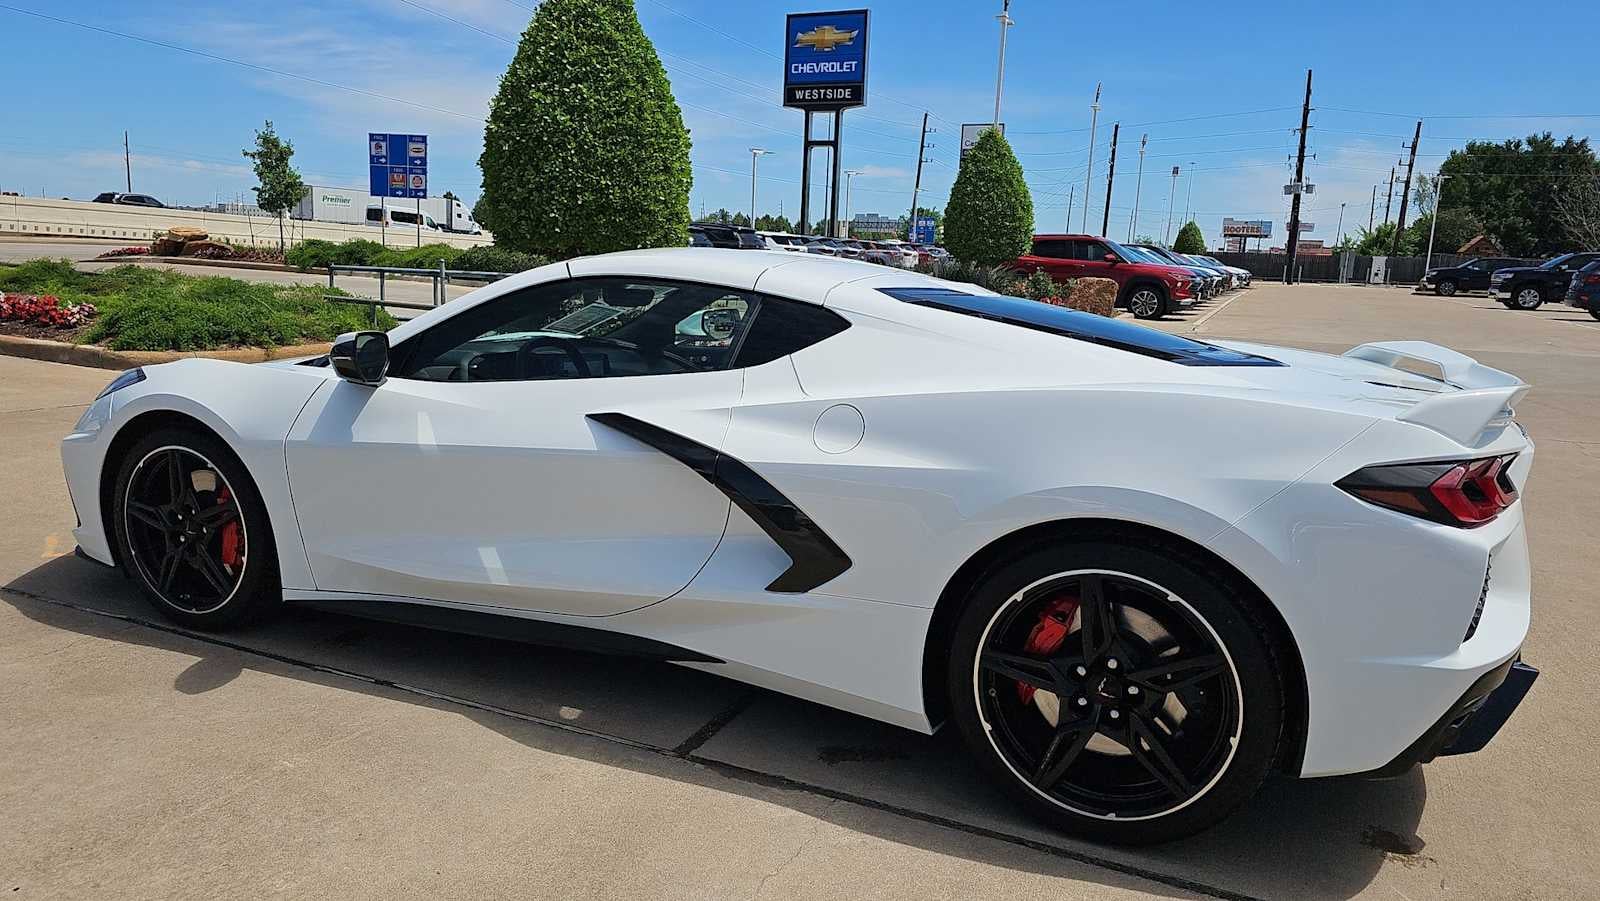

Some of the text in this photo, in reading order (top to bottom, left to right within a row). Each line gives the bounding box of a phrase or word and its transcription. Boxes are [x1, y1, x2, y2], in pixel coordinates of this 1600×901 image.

[791, 61, 858, 74] CHEVROLET
[795, 88, 852, 100] WESTSIDE
[322, 195, 351, 204] Premier
[1223, 225, 1260, 234] HOOTERS
